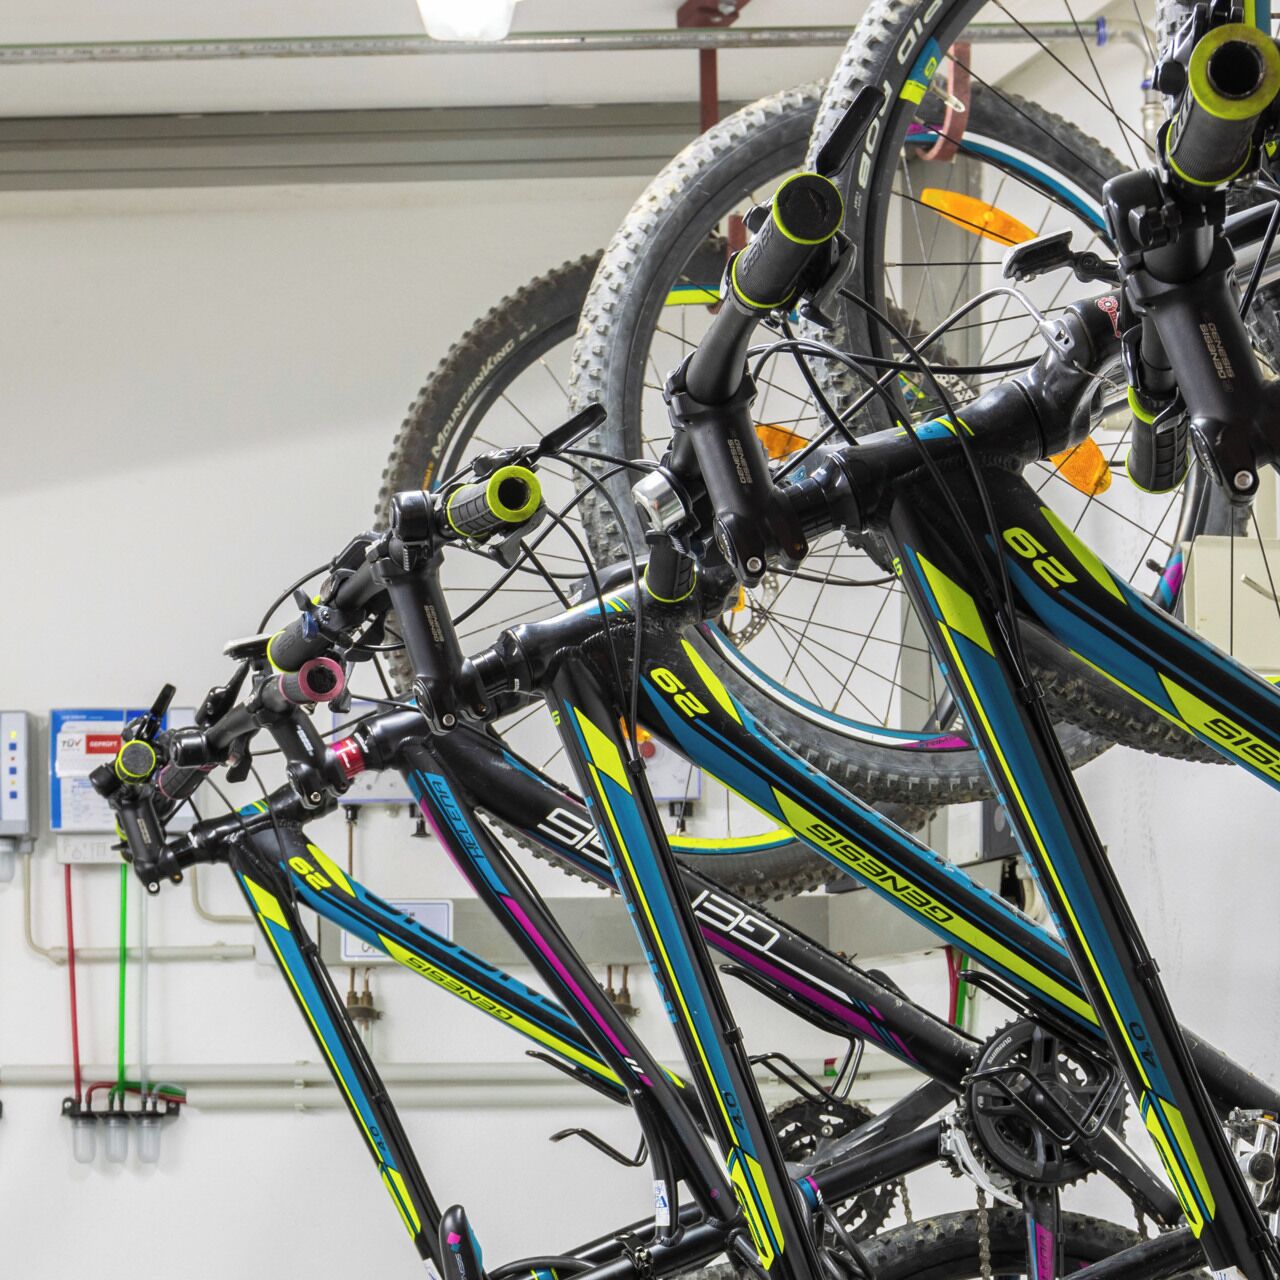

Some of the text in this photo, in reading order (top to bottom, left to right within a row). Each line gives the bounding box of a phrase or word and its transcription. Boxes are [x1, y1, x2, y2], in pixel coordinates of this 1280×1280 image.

[1002, 527, 1079, 589] 29
[650, 667, 710, 718] 29
[432, 779, 485, 861] HELENA
[288, 856, 332, 892] 29
[806, 823, 955, 924] GENESIS
[407, 956, 513, 1022] GENESIS
[1129, 1021, 1157, 1069] 4.0
[723, 1091, 746, 1130] 4.0
